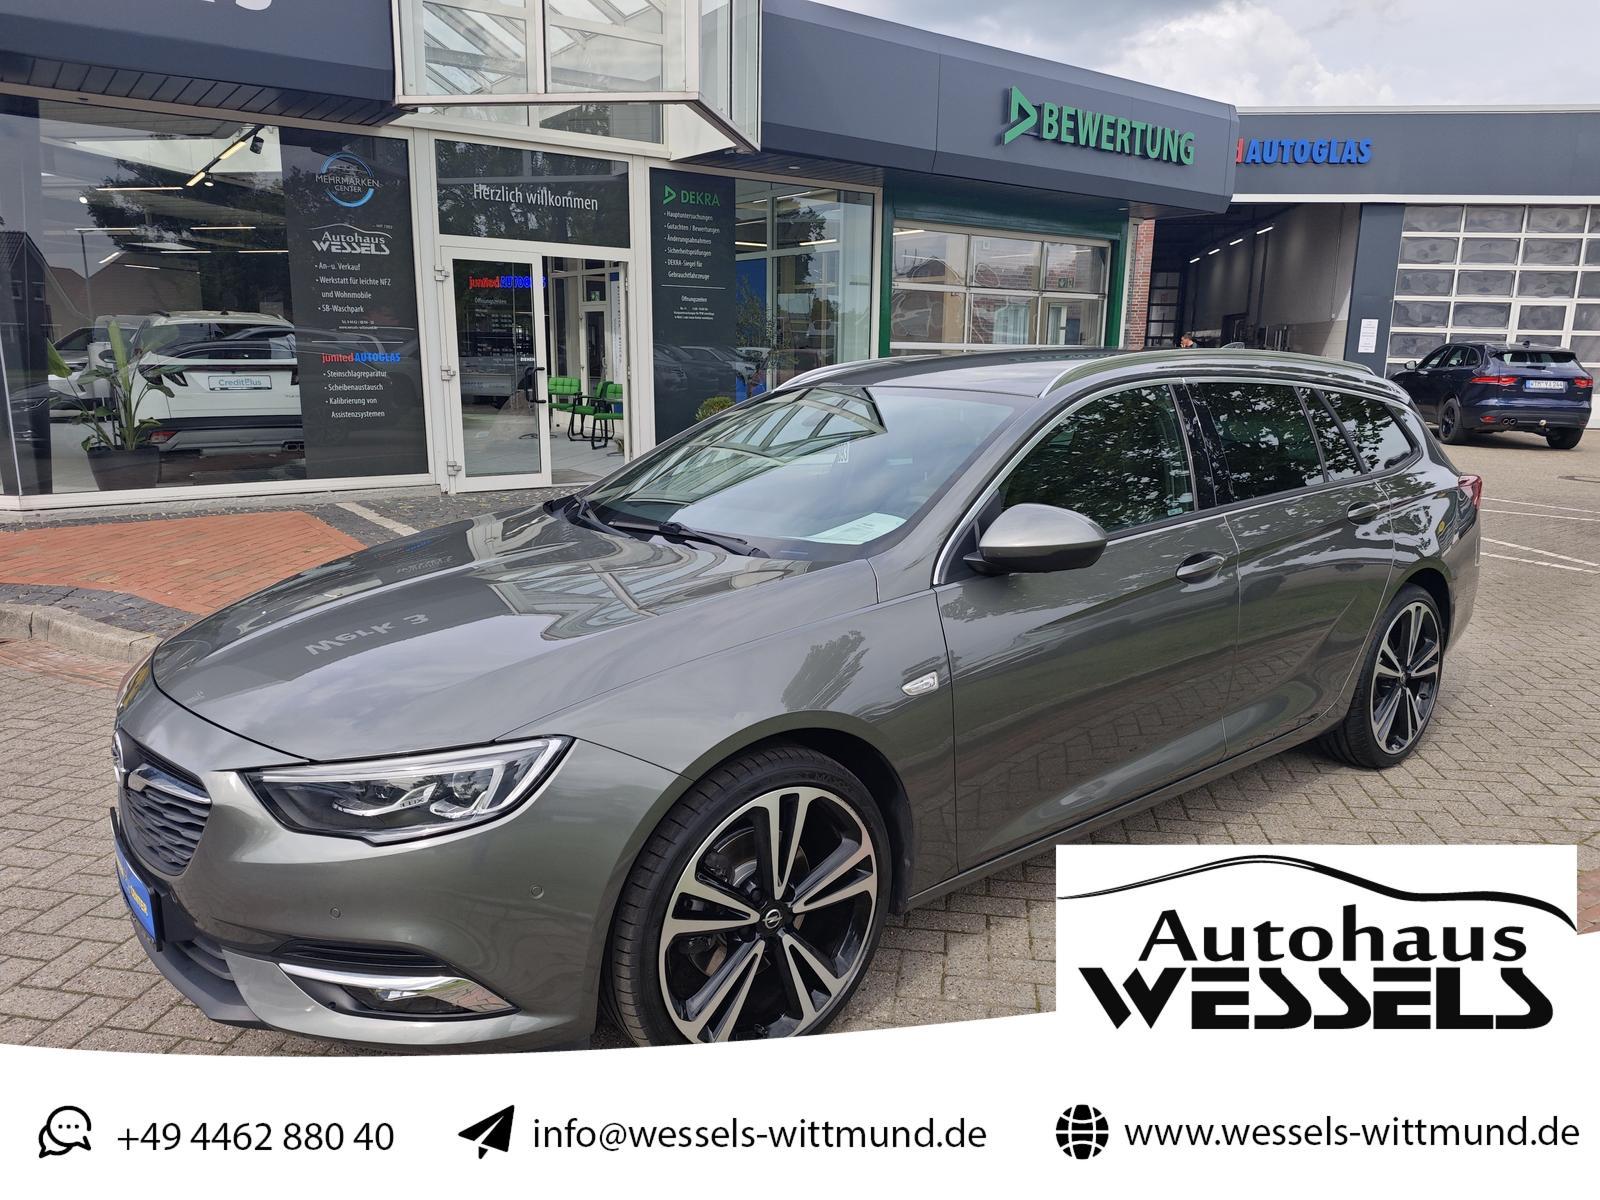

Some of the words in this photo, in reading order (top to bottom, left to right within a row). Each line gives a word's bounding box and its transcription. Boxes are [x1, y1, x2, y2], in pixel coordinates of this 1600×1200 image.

[1041, 101, 1195, 166] BEWERTUNG
[1244, 137, 1372, 164] AUTOGLAS
[334, 184, 362, 193] CENTER
[473, 183, 523, 203] Herzlich
[526, 189, 598, 211] willkommen
[681, 190, 720, 207] DEKRA
[321, 231, 385, 244] Autohaus
[312, 240, 390, 255] WESSELS
[337, 262, 360, 271] Verkauf
[320, 276, 349, 285] Werkstatt
[349, 277, 359, 285] für
[360, 277, 379, 286] leichte
[380, 277, 391, 286] NFZ
[321, 290, 333, 298] und
[334, 291, 372, 299] Wohnmobile
[321, 304, 364, 314] SB-Waschpark
[321, 352, 354, 363] junited
[354, 352, 401, 362] AUTOGLAS
[326, 369, 387, 379] Steinschlagreparatur
[218, 377, 262, 387] CreditPlus
[327, 383, 384, 392] Scheibenaustausch
[329, 397, 366, 406] Kalibrierung
[331, 410, 386, 419] Assistenzsystemen
